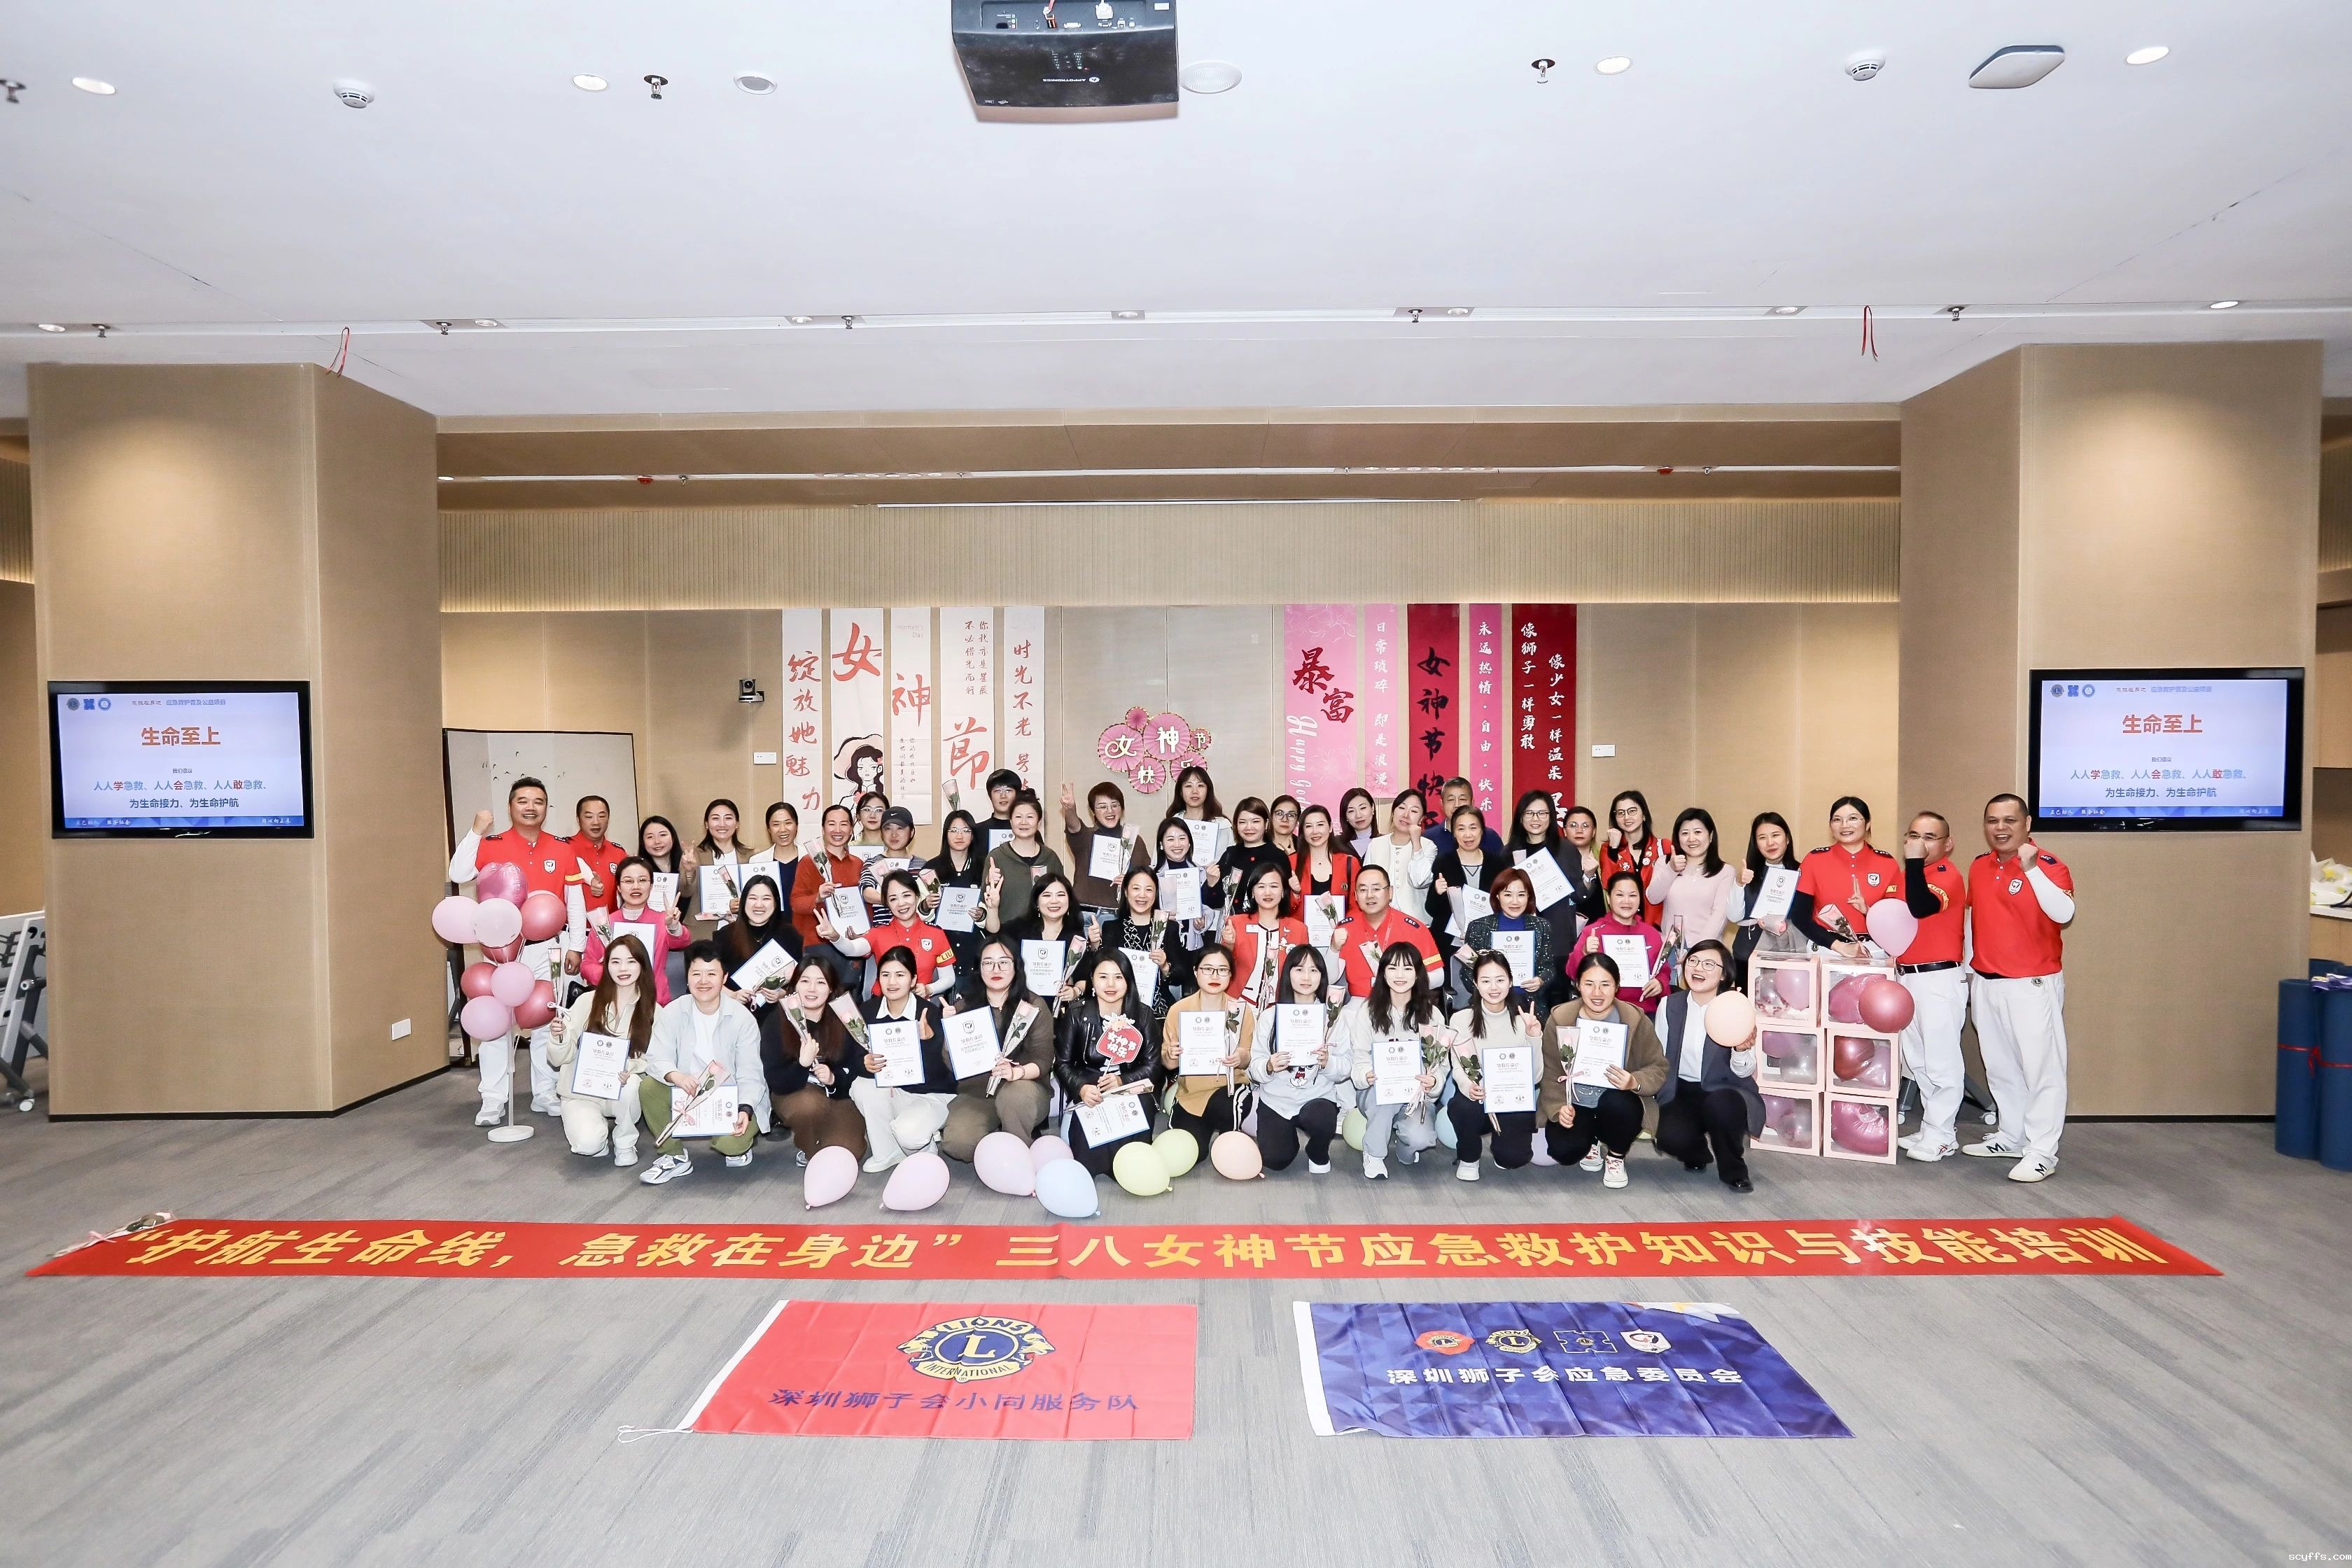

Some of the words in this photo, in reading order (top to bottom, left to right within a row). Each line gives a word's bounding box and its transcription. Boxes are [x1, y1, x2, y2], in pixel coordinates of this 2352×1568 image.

[832, 622, 882, 682] 女
[965, 621, 974, 694] 不必借光而行
[979, 621, 988, 694] 你我亦是星辰
[1374, 622, 1389, 693] 日常琐碎
[892, 673, 930, 727] 神
[1013, 639, 1032, 736] 时光不老
[1293, 647, 1354, 723] 暴富
[1520, 622, 1537, 750] 像狮子一样勇敢
[141, 727, 221, 746] 生命至上
[785, 651, 821, 810] 绽放她魅力
[1287, 715, 1318, 772] Happy
[1548, 653, 1565, 780] 像少女一样温柔
[2122, 714, 2203, 734] 生命至上
[1374, 713, 1389, 785] 即是浪漫
[995, 1228, 2169, 1268] 三八女神节应急救护知识与技能培训
[943, 1318, 1031, 1334] LIONS
[958, 1334, 996, 1358] L
[923, 1362, 1014, 1377] INTERNATIONAL
[1386, 1365, 1743, 1385] 深圳狮子会应急委员会
[768, 1390, 1140, 1410] 深圳狮子会小同服务队
